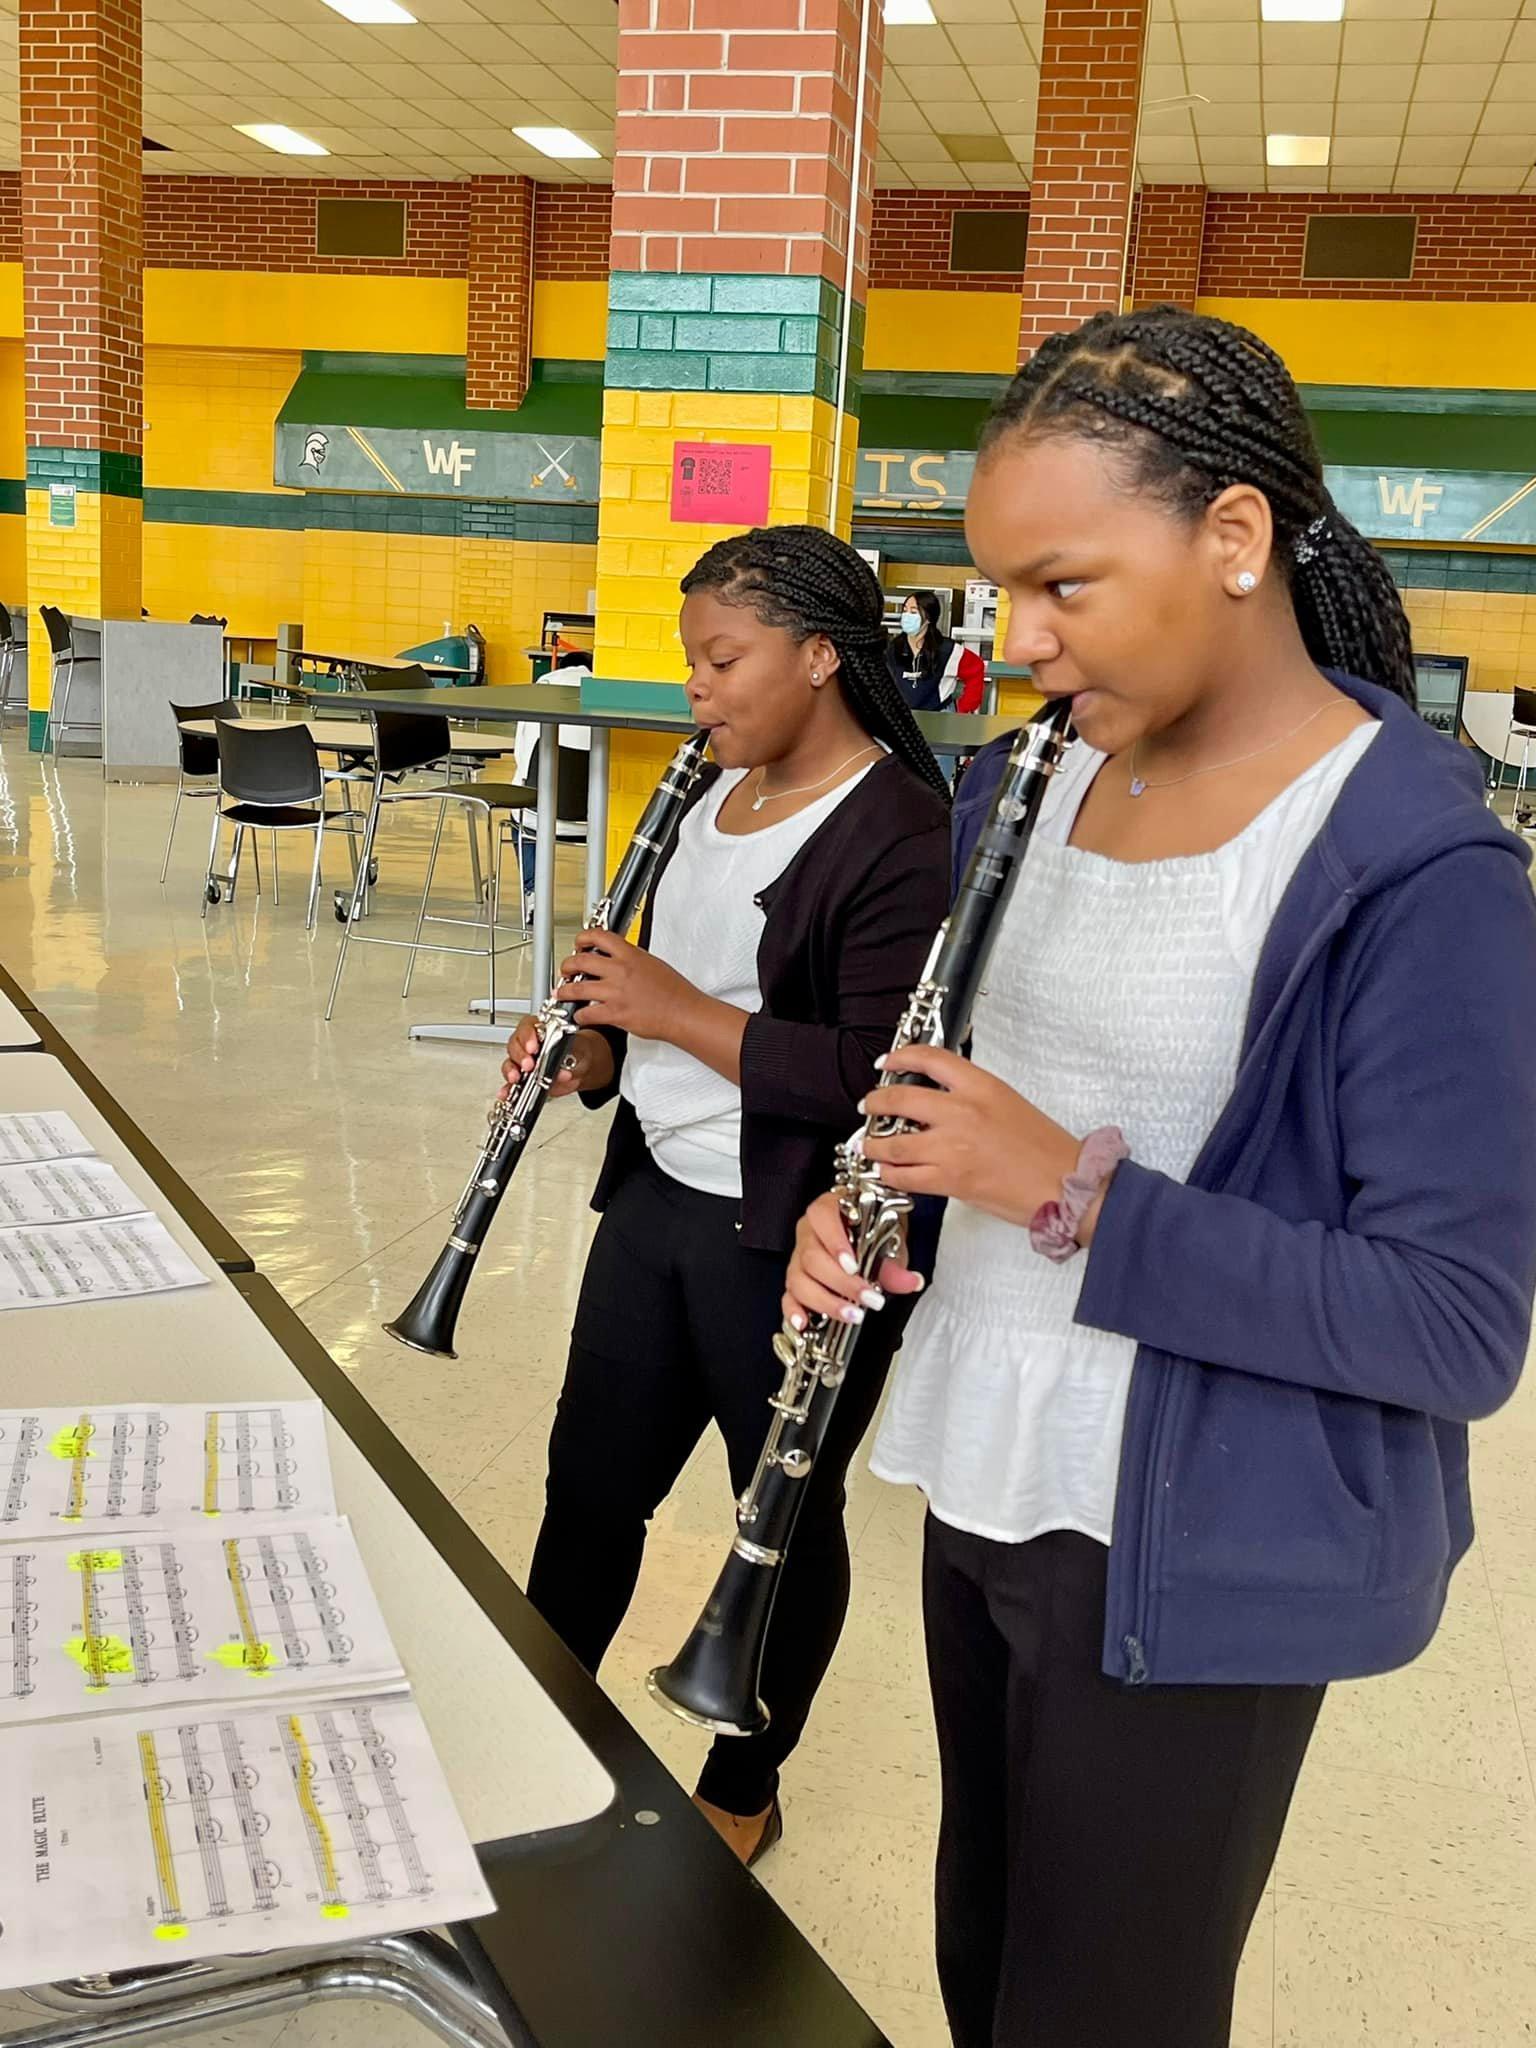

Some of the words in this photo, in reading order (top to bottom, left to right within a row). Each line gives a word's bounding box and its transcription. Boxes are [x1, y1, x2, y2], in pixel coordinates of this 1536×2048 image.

[423, 439, 476, 486] WF
[862, 453, 947, 510] IS
[1378, 476, 1443, 527] WF
[32, 1796, 47, 1824] FLUTE
[33, 1827, 49, 1858] MAGIC
[35, 1862, 50, 1882] THE
